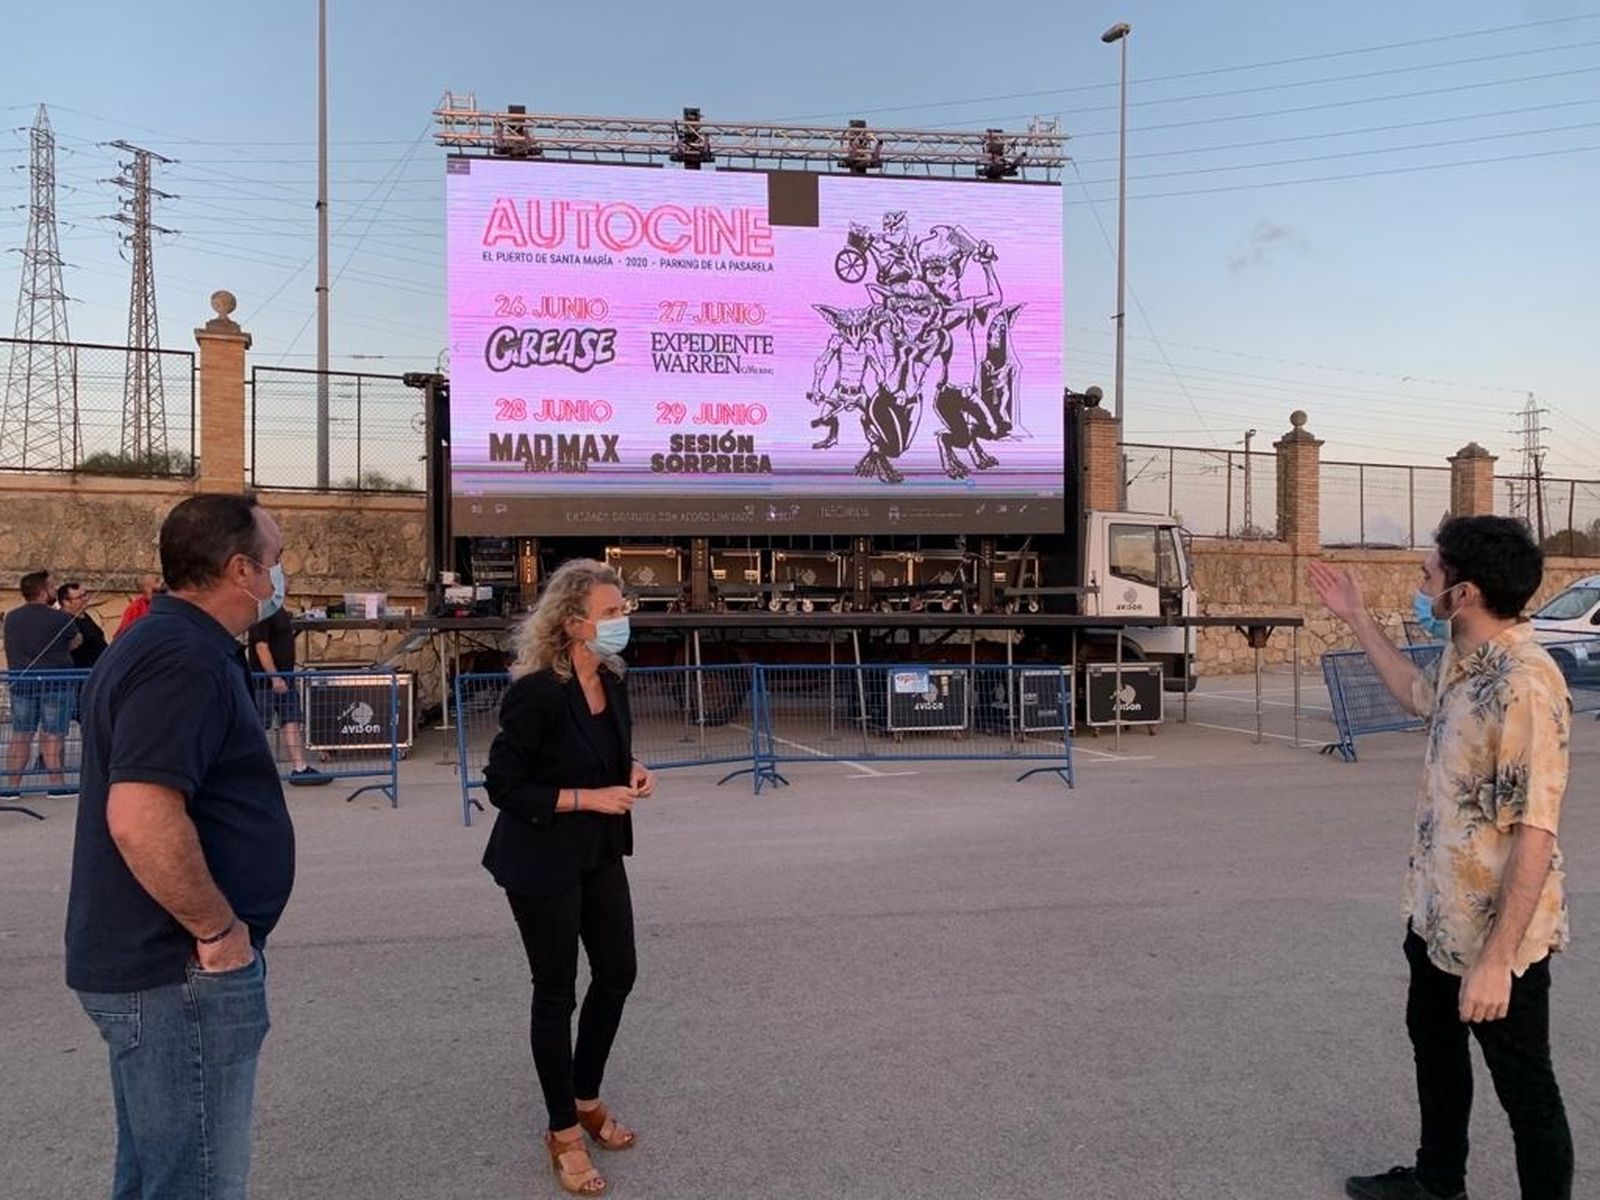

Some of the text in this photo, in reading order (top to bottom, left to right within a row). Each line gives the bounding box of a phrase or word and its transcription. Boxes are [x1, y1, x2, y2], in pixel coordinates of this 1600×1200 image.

[482, 198, 775, 258] AUTOCINE
[482, 252, 774, 272] EL PUERTO DE SANTA MARÍA 2020 PARKING DE LA PASARELA
[494, 294, 608, 321] 26 JUNIO
[658, 300, 766, 325] 27 JUNIO
[485, 325, 617, 373] GREASE
[651, 332, 774, 355] EXPEDIENTE
[651, 354, 741, 375] WARREN
[495, 398, 613, 423] 28 JUNIO
[656, 401, 767, 426] 29 JUNIO
[489, 433, 621, 463] MAD MAX
[670, 430, 754, 454] SESIÓN
[650, 453, 773, 474] SORPRESA
